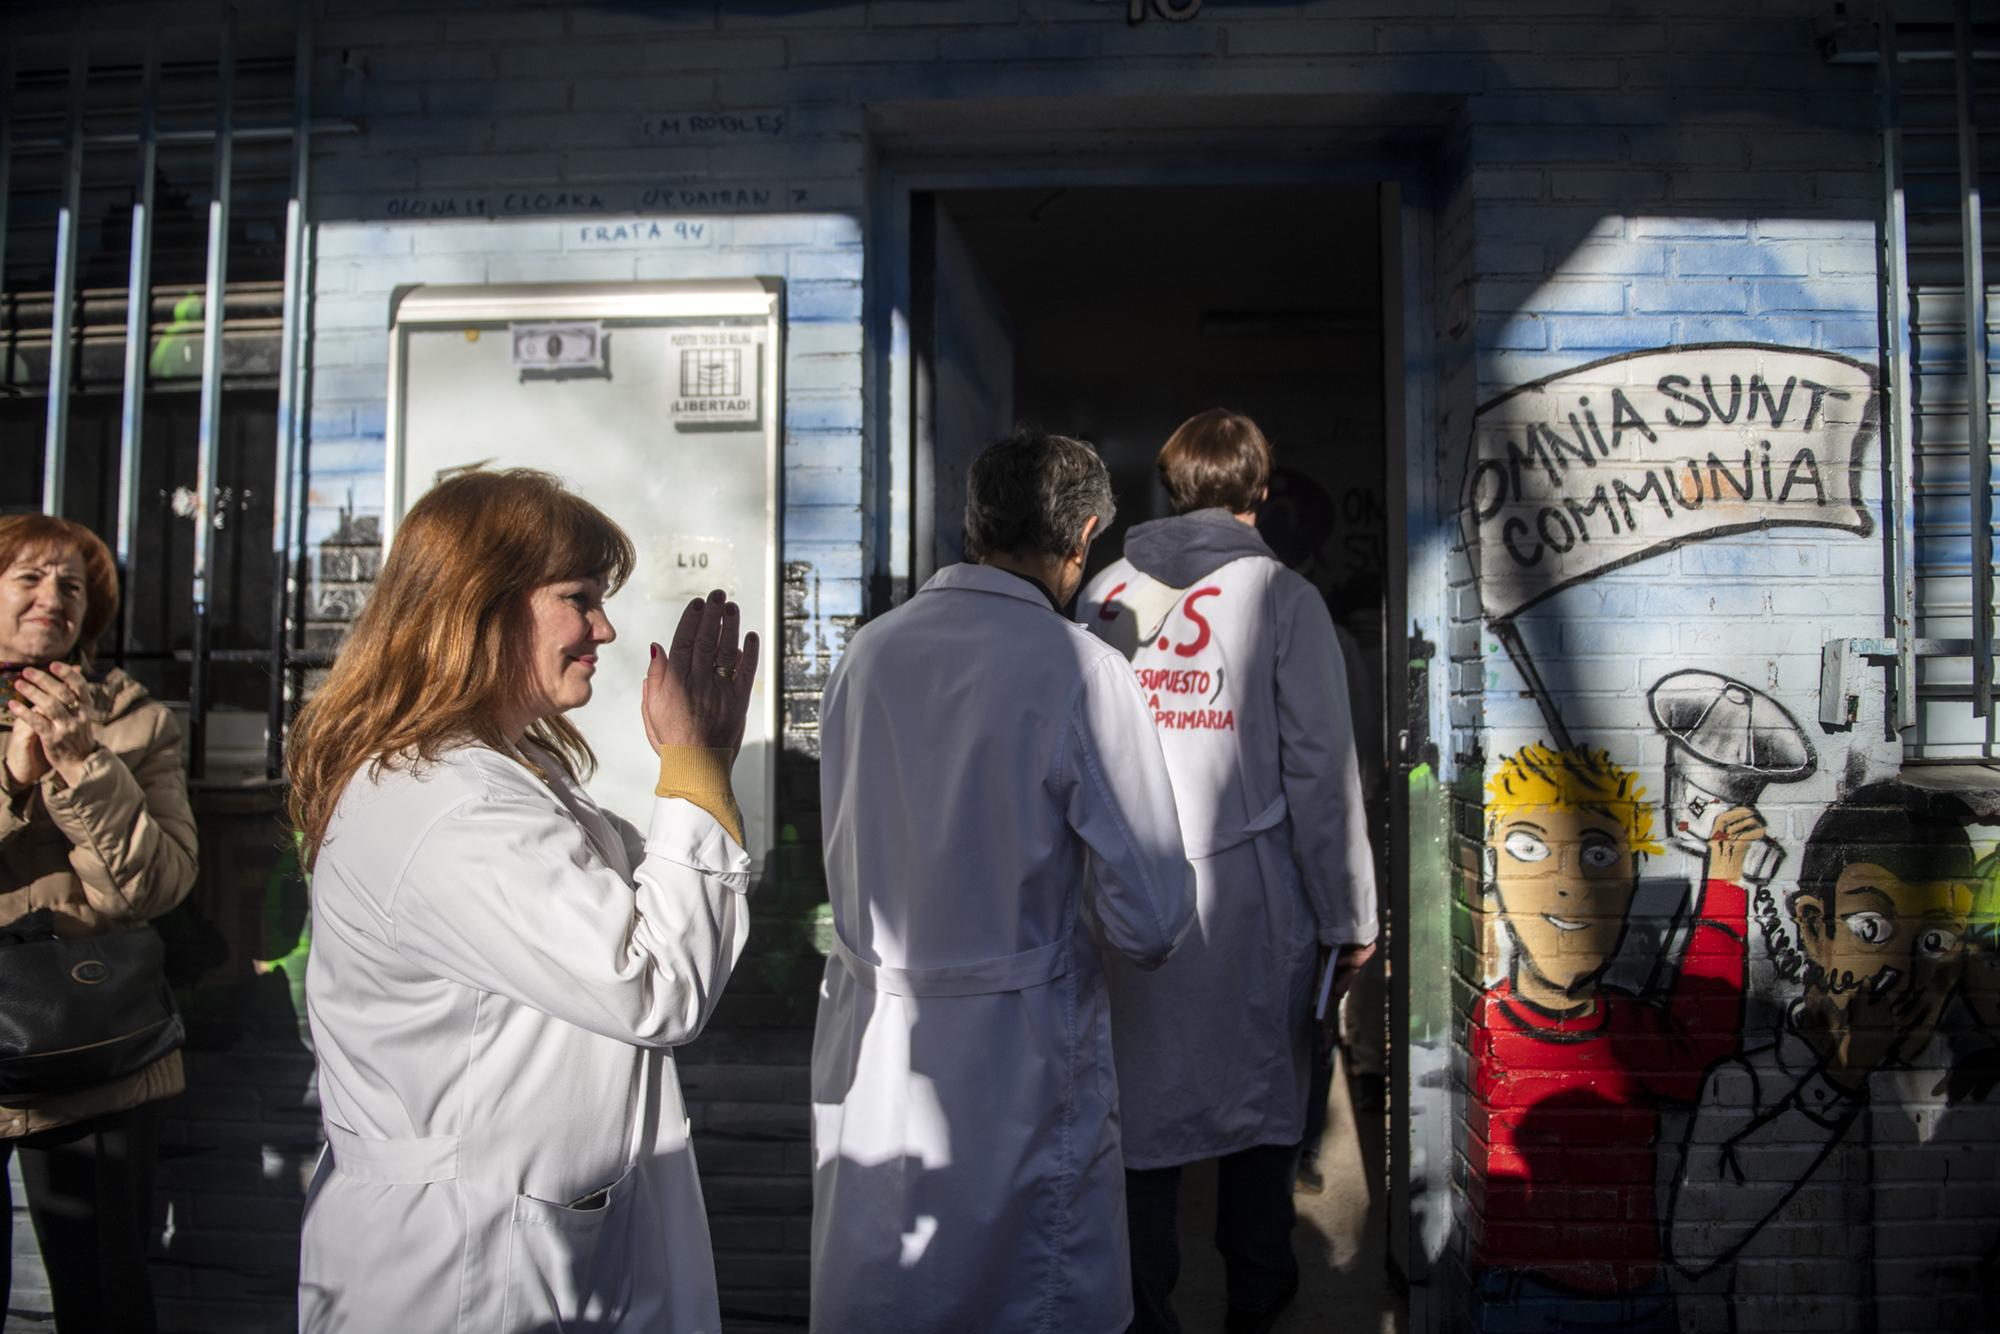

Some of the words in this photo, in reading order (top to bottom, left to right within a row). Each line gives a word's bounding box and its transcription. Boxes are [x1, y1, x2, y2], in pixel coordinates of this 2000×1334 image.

[671, 400, 750, 413] ¡LIBERTAD!
[1656, 374, 1851, 433] SUNT
[677, 552, 709, 569] L10
[1155, 709, 1235, 732] PRIMARIA
